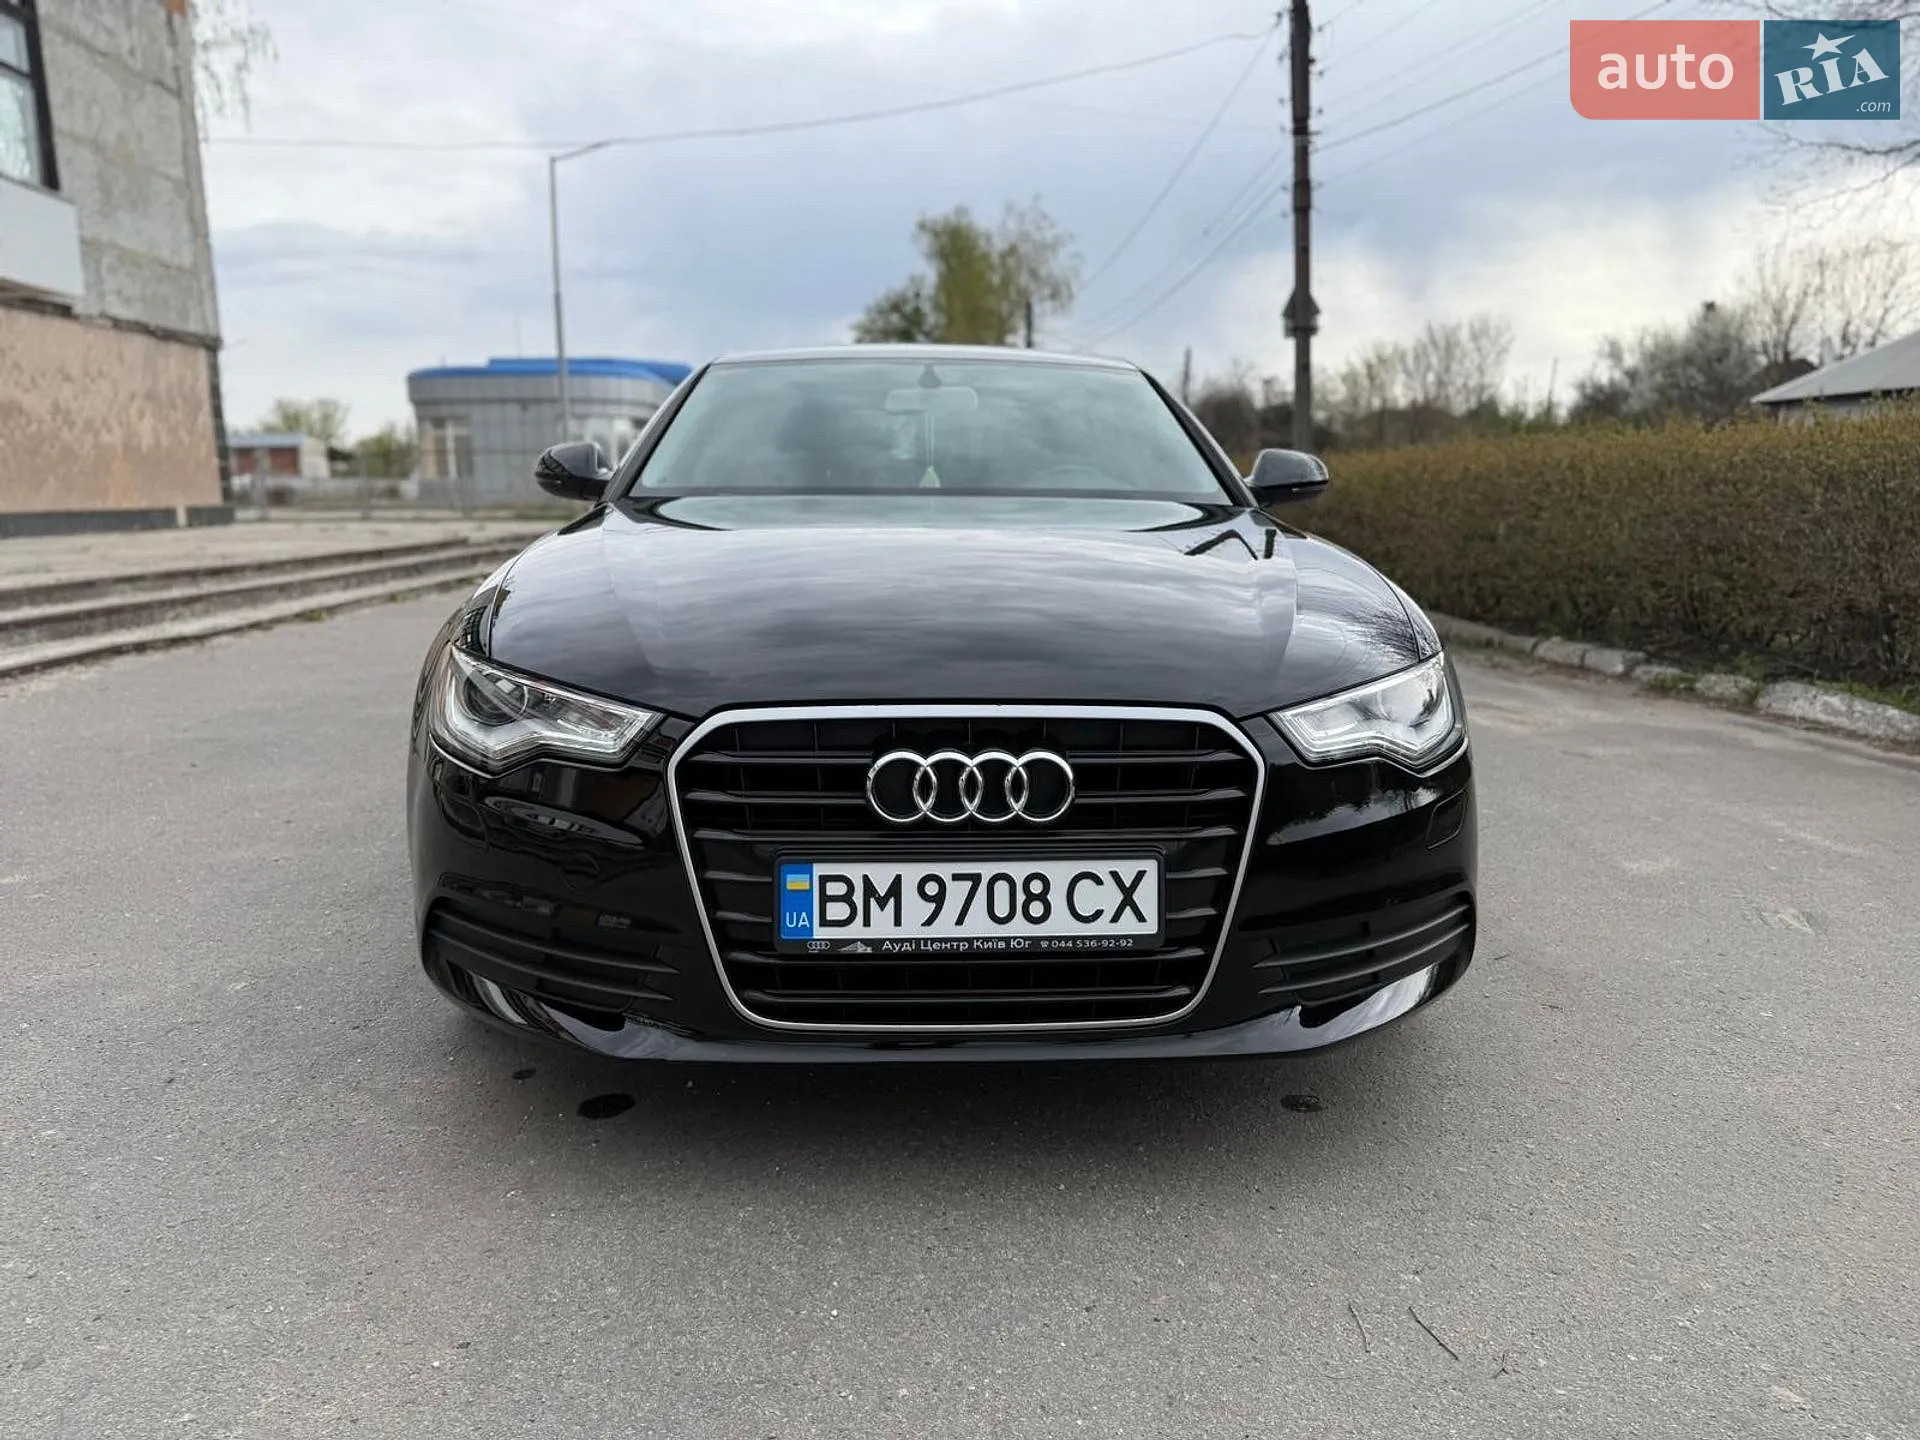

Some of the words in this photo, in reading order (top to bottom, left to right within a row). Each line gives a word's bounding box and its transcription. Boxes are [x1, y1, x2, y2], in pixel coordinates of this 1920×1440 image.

[818, 873, 903, 928] BM
[916, 871, 1053, 927] 9708
[1066, 869, 1148, 925] CX
[785, 911, 810, 928] UA
[881, 939, 917, 952] Ауді
[920, 939, 969, 953] Центр
[973, 938, 1006, 950] Київ
[1009, 938, 1032, 949] Юг
[1051, 939, 1073, 948] 044
